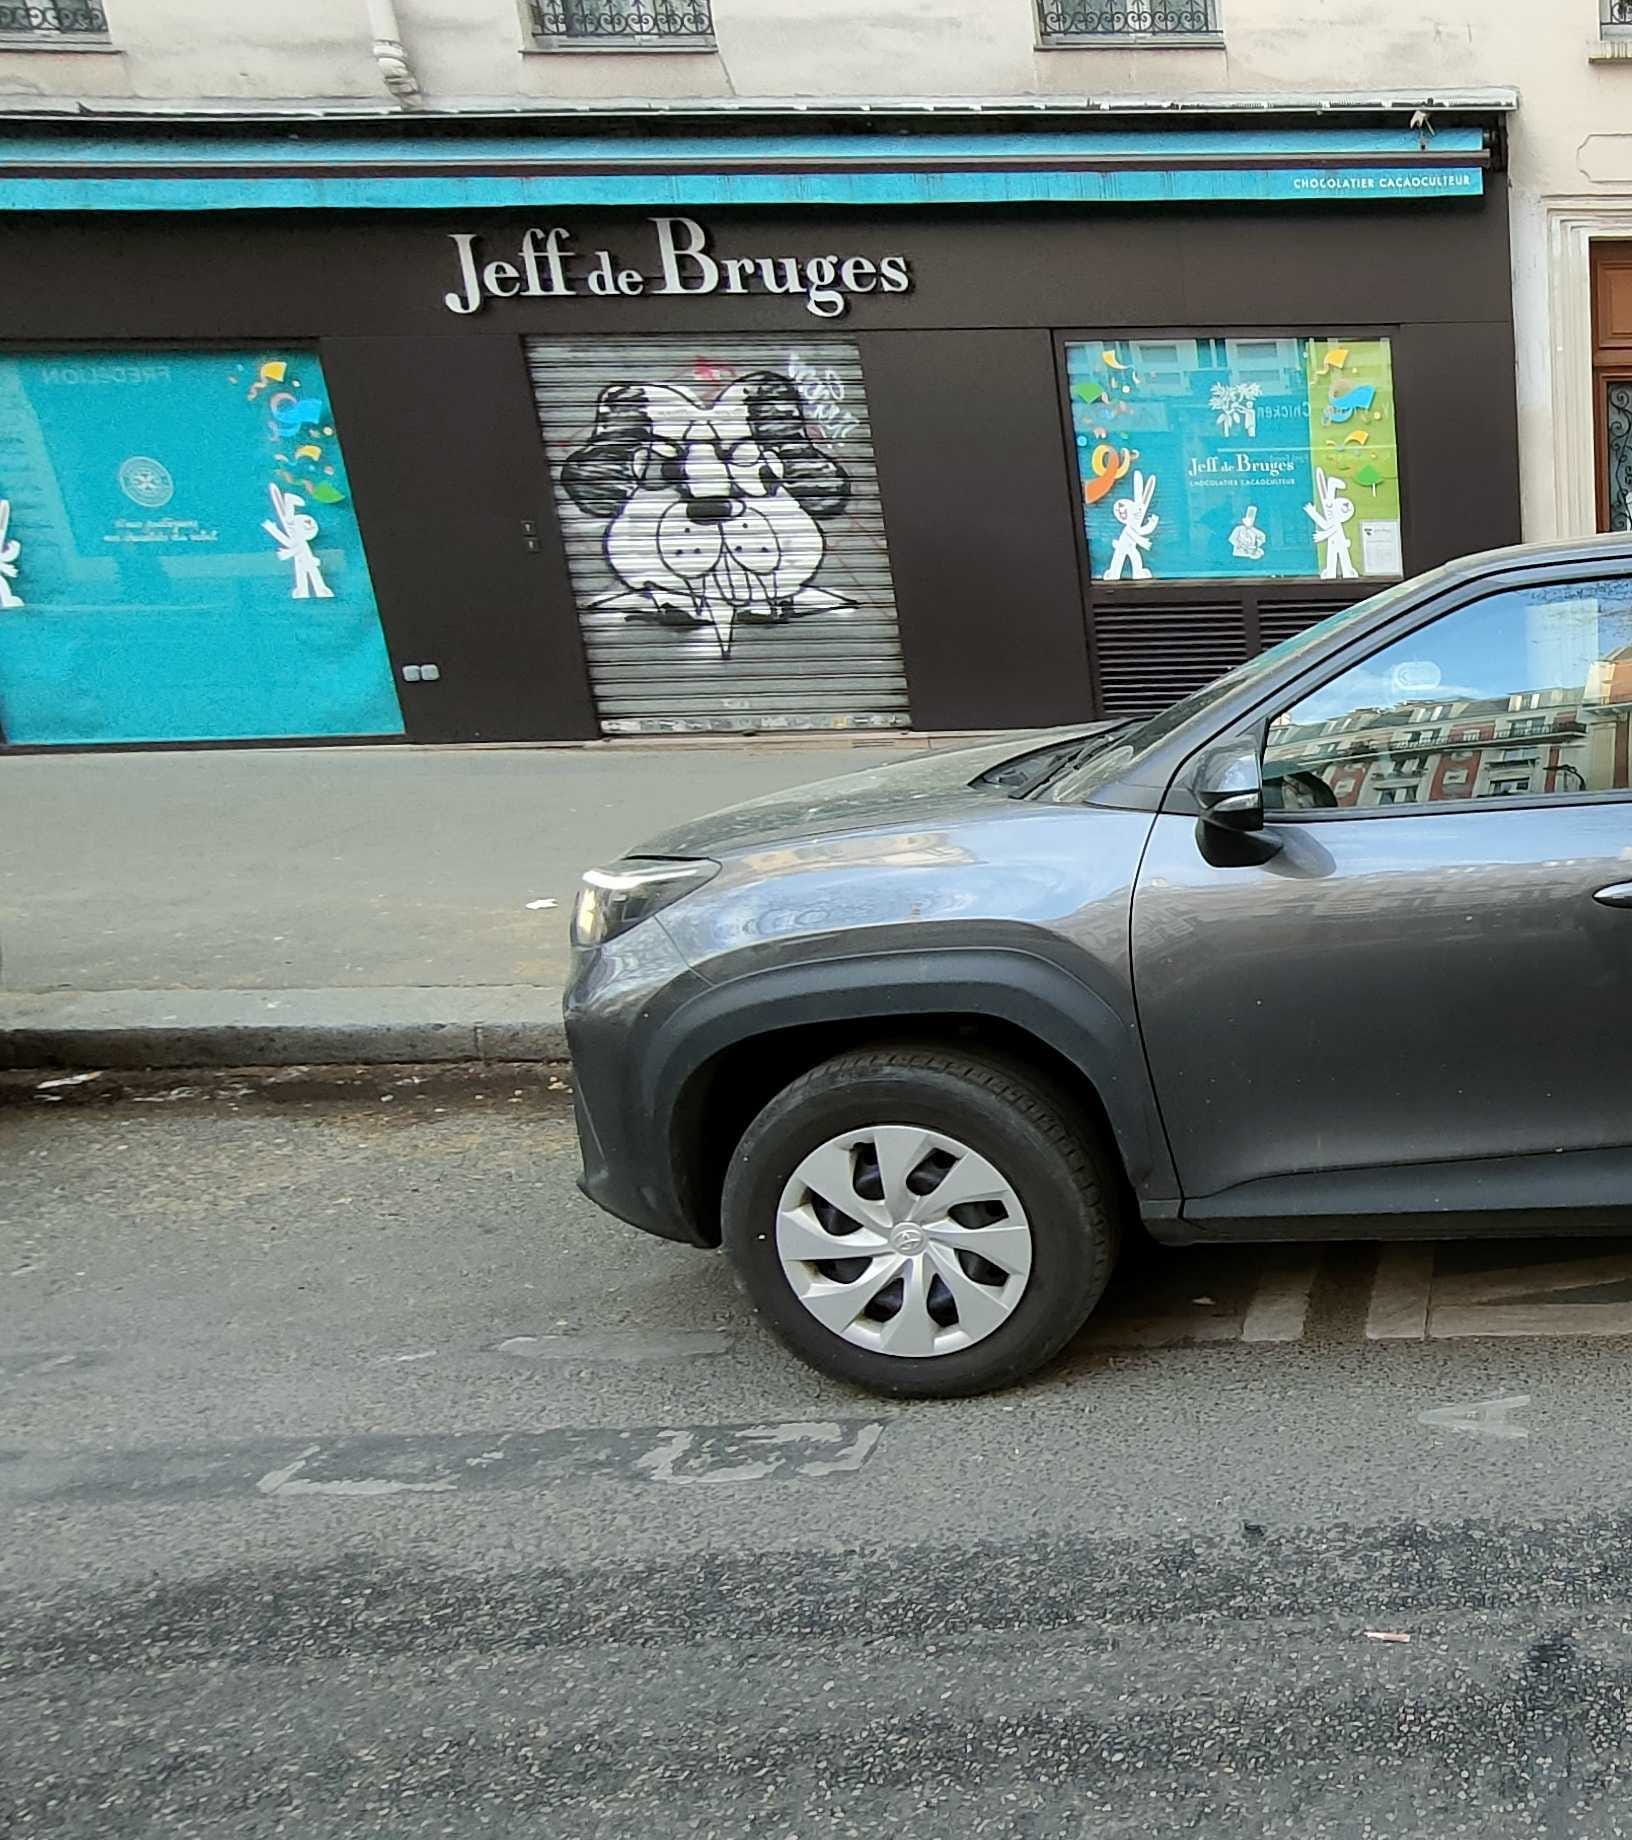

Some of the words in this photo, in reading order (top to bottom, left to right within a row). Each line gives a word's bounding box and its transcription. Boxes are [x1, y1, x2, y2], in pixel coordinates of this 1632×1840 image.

[1293, 177, 1375, 189] CHOCOLATIER
[1379, 175, 1471, 188] CACAOCULTEUR
[445, 227, 574, 315] Jeff
[587, 250, 643, 296] de
[648, 216, 910, 318] Bruges
[1188, 456, 1219, 477] Jeff
[1236, 453, 1295, 477] Bruges
